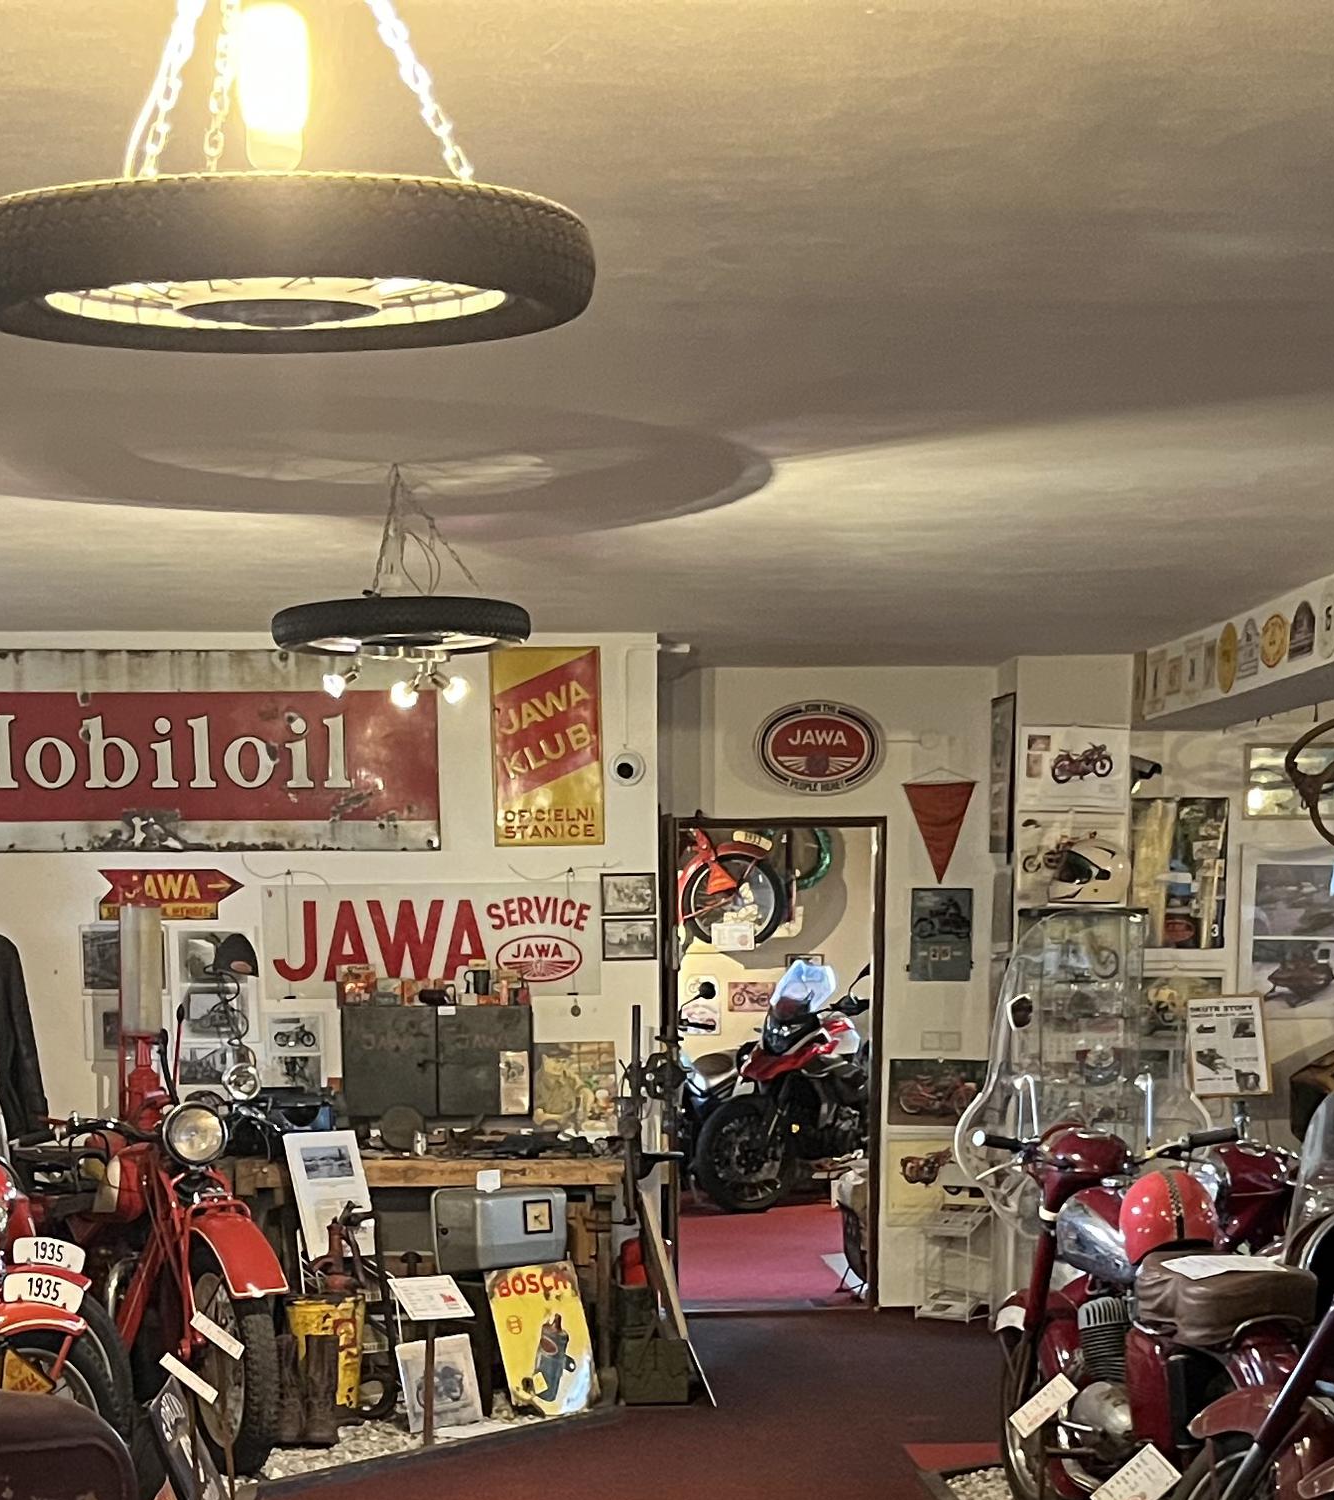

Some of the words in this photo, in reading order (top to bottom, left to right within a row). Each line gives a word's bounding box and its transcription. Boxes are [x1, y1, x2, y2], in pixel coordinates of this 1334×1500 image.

[498, 680, 591, 735] JAWA
[787, 729, 848, 746] JAWA
[503, 723, 591, 780] KLUB
[504, 823, 596, 840] STANICE
[273, 899, 488, 983] JAWA
[486, 895, 593, 932] SERVICE
[511, 942, 563, 959] JAWA
[32, 1240, 65, 1263] 1935
[27, 1276, 62, 1302] 1935
[497, 1272, 569, 1299] BOSCH
